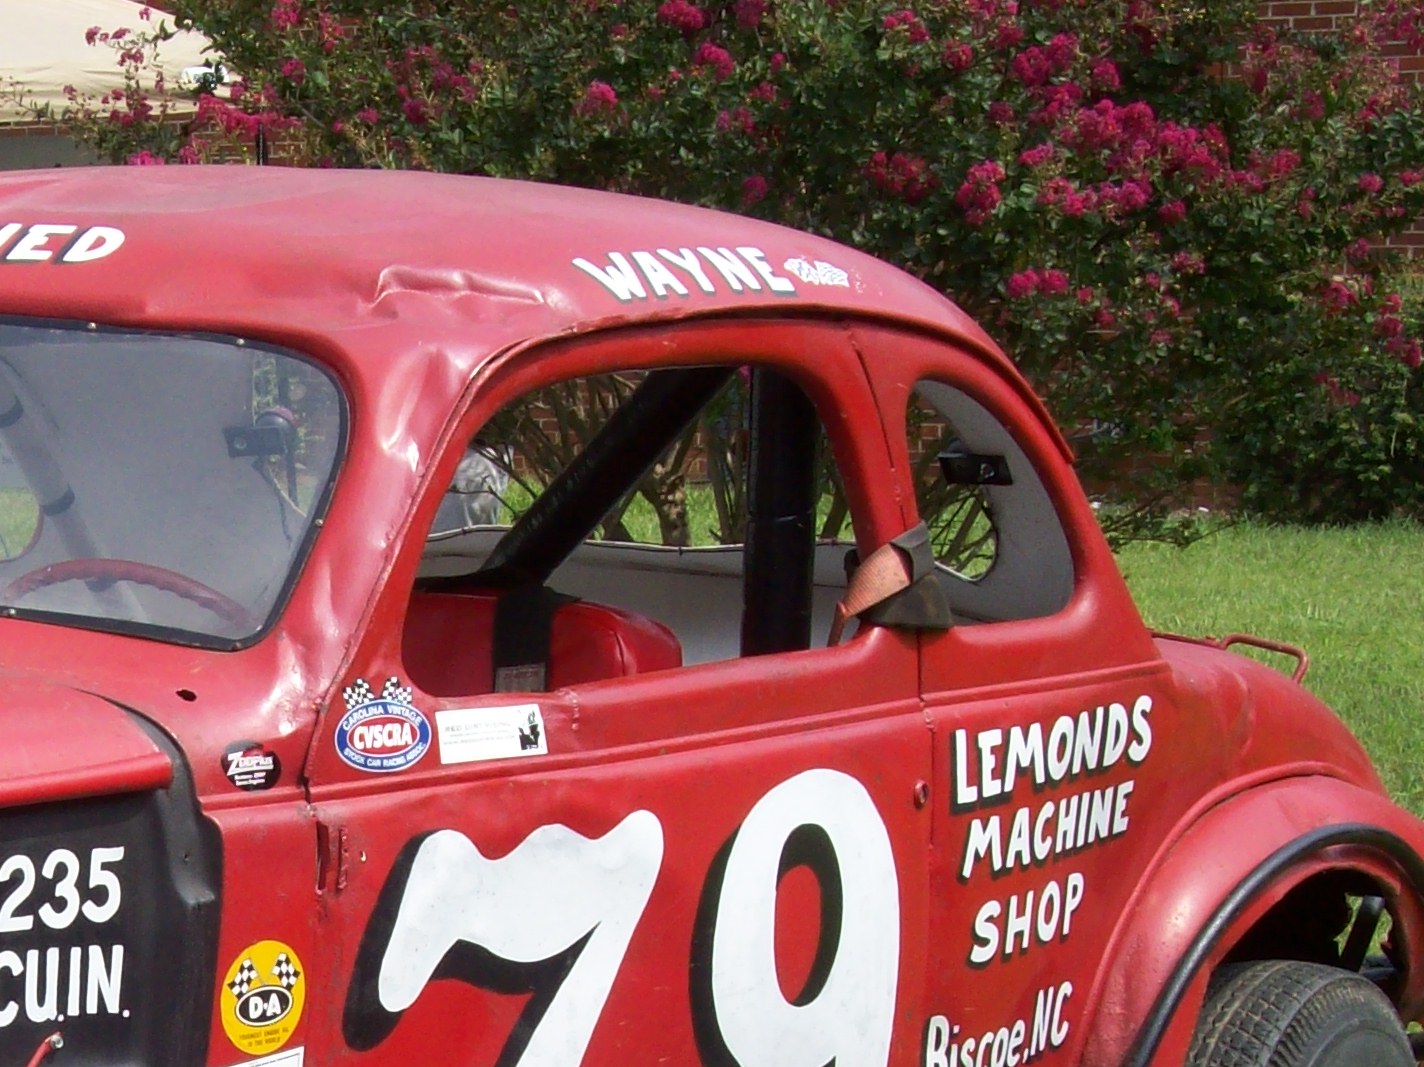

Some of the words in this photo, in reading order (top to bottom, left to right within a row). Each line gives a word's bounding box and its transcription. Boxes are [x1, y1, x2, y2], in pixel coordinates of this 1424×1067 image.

[572, 247, 796, 300] WAYNE
[343, 704, 385, 731] CAROLINA
[386, 704, 423, 727] VINTAGE
[353, 722, 413, 750] CVSCRA
[366, 758, 382, 767] CAR
[955, 695, 1153, 805] LEMONDS
[962, 780, 1135, 879] MACHINE
[970, 872, 1085, 964] SHOP
